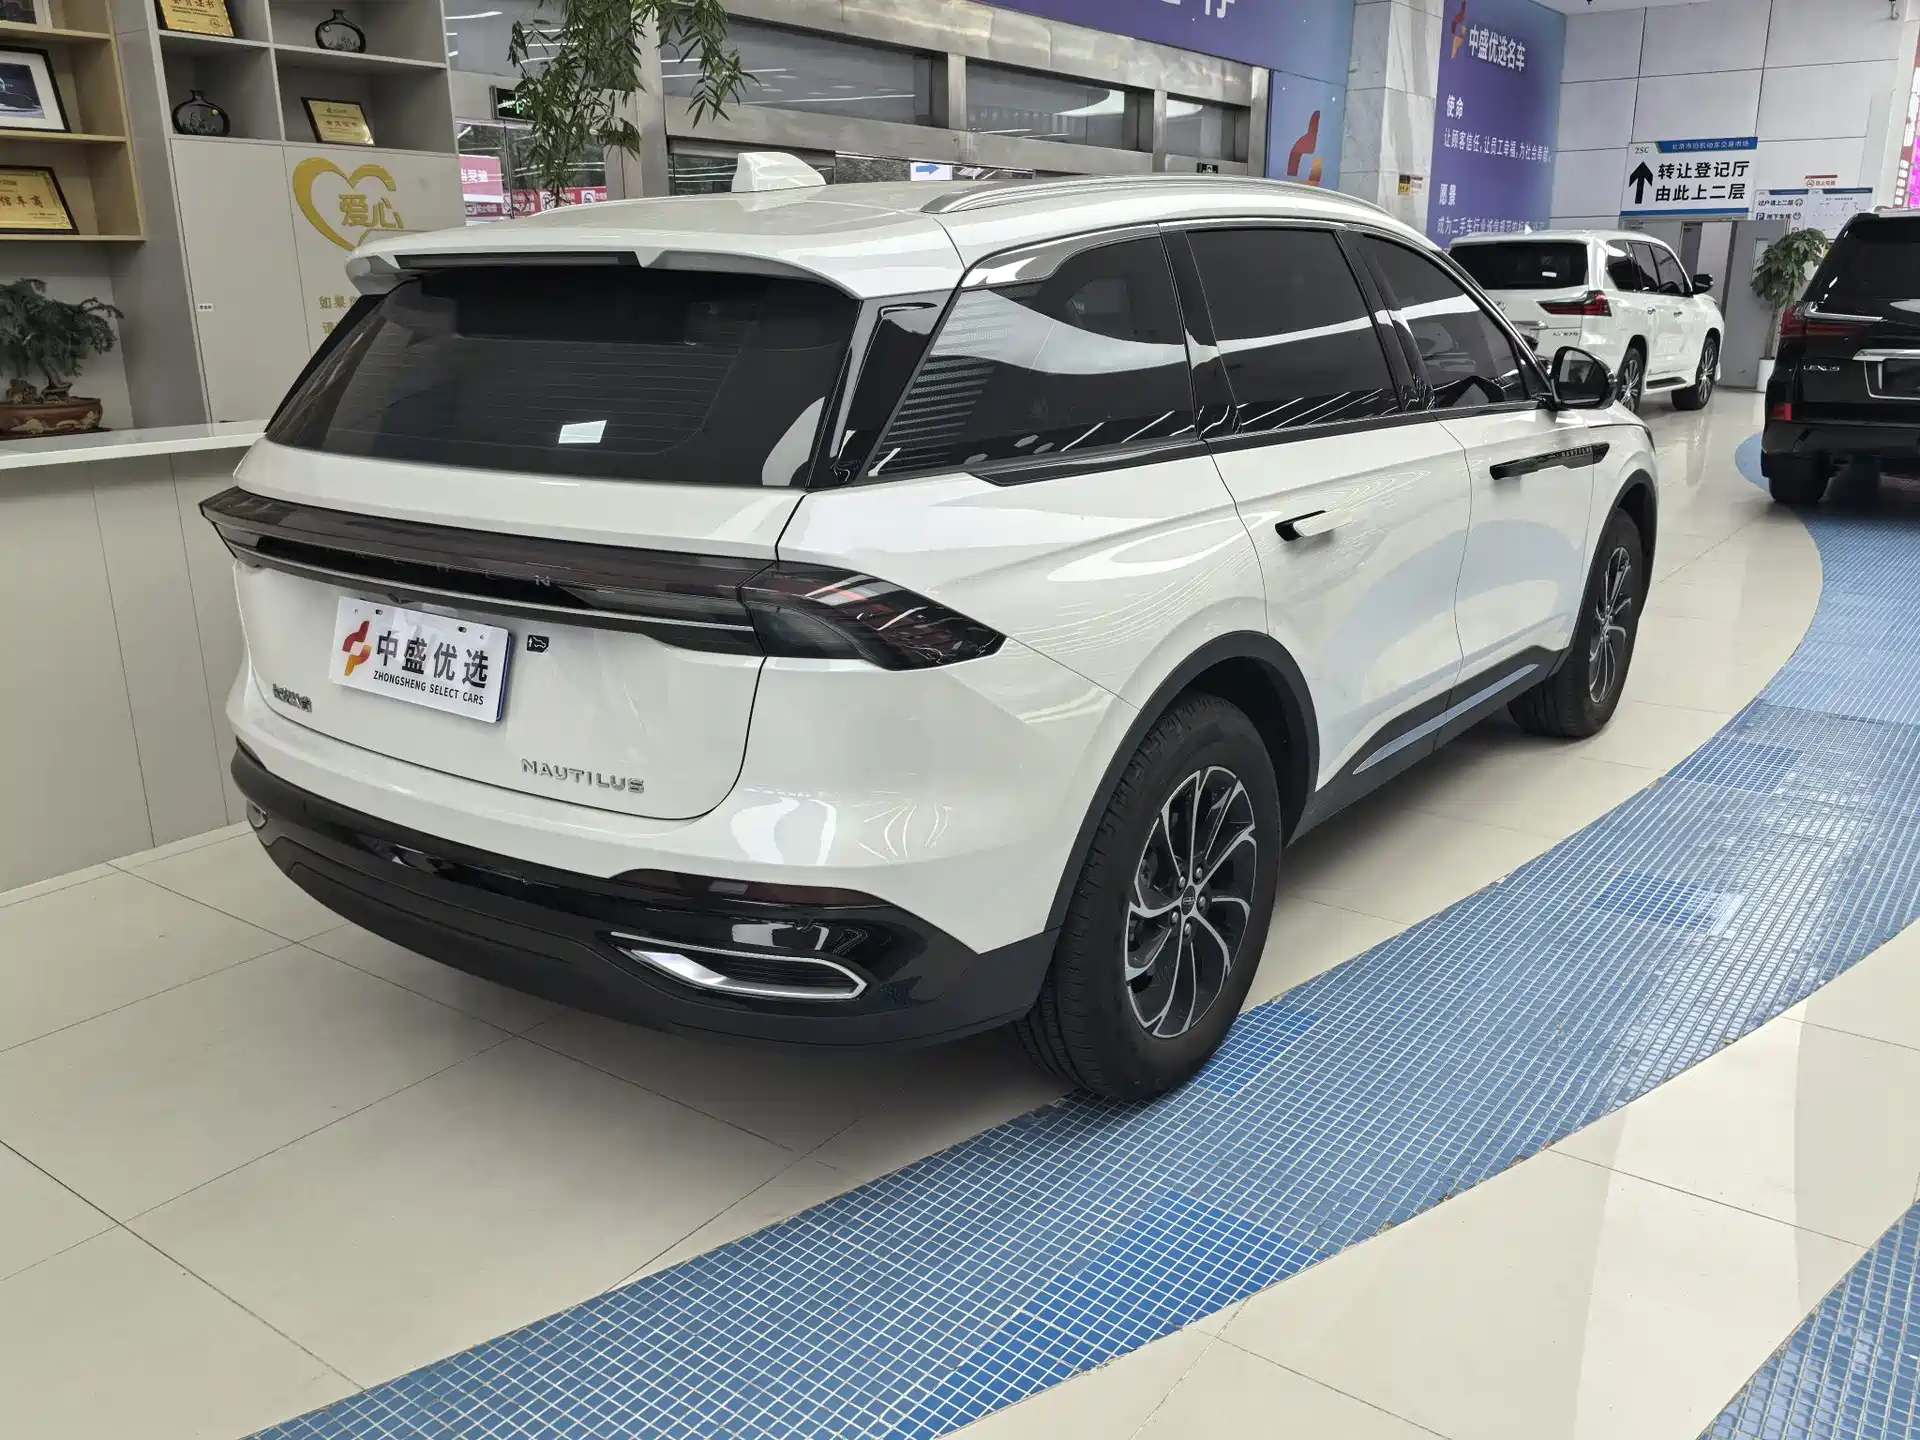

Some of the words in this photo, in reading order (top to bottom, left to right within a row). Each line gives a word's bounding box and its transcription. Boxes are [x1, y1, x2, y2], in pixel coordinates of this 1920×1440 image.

[1469, 24, 1525, 72] 中盛优选名车
[1446, 94, 1464, 119] 使命
[1658, 160, 1750, 180] 转让登记厅
[1439, 183, 1457, 206] 愿景
[1655, 183, 1746, 202] 由此上二层
[338, 194, 404, 229] 爱心
[376, 630, 489, 689] 中盛优选
[373, 670, 427, 692] ZHONGSHENG
[429, 683, 459, 699] SELECT
[462, 691, 484, 706] CARS
[521, 758, 645, 794] NAUTILUS
